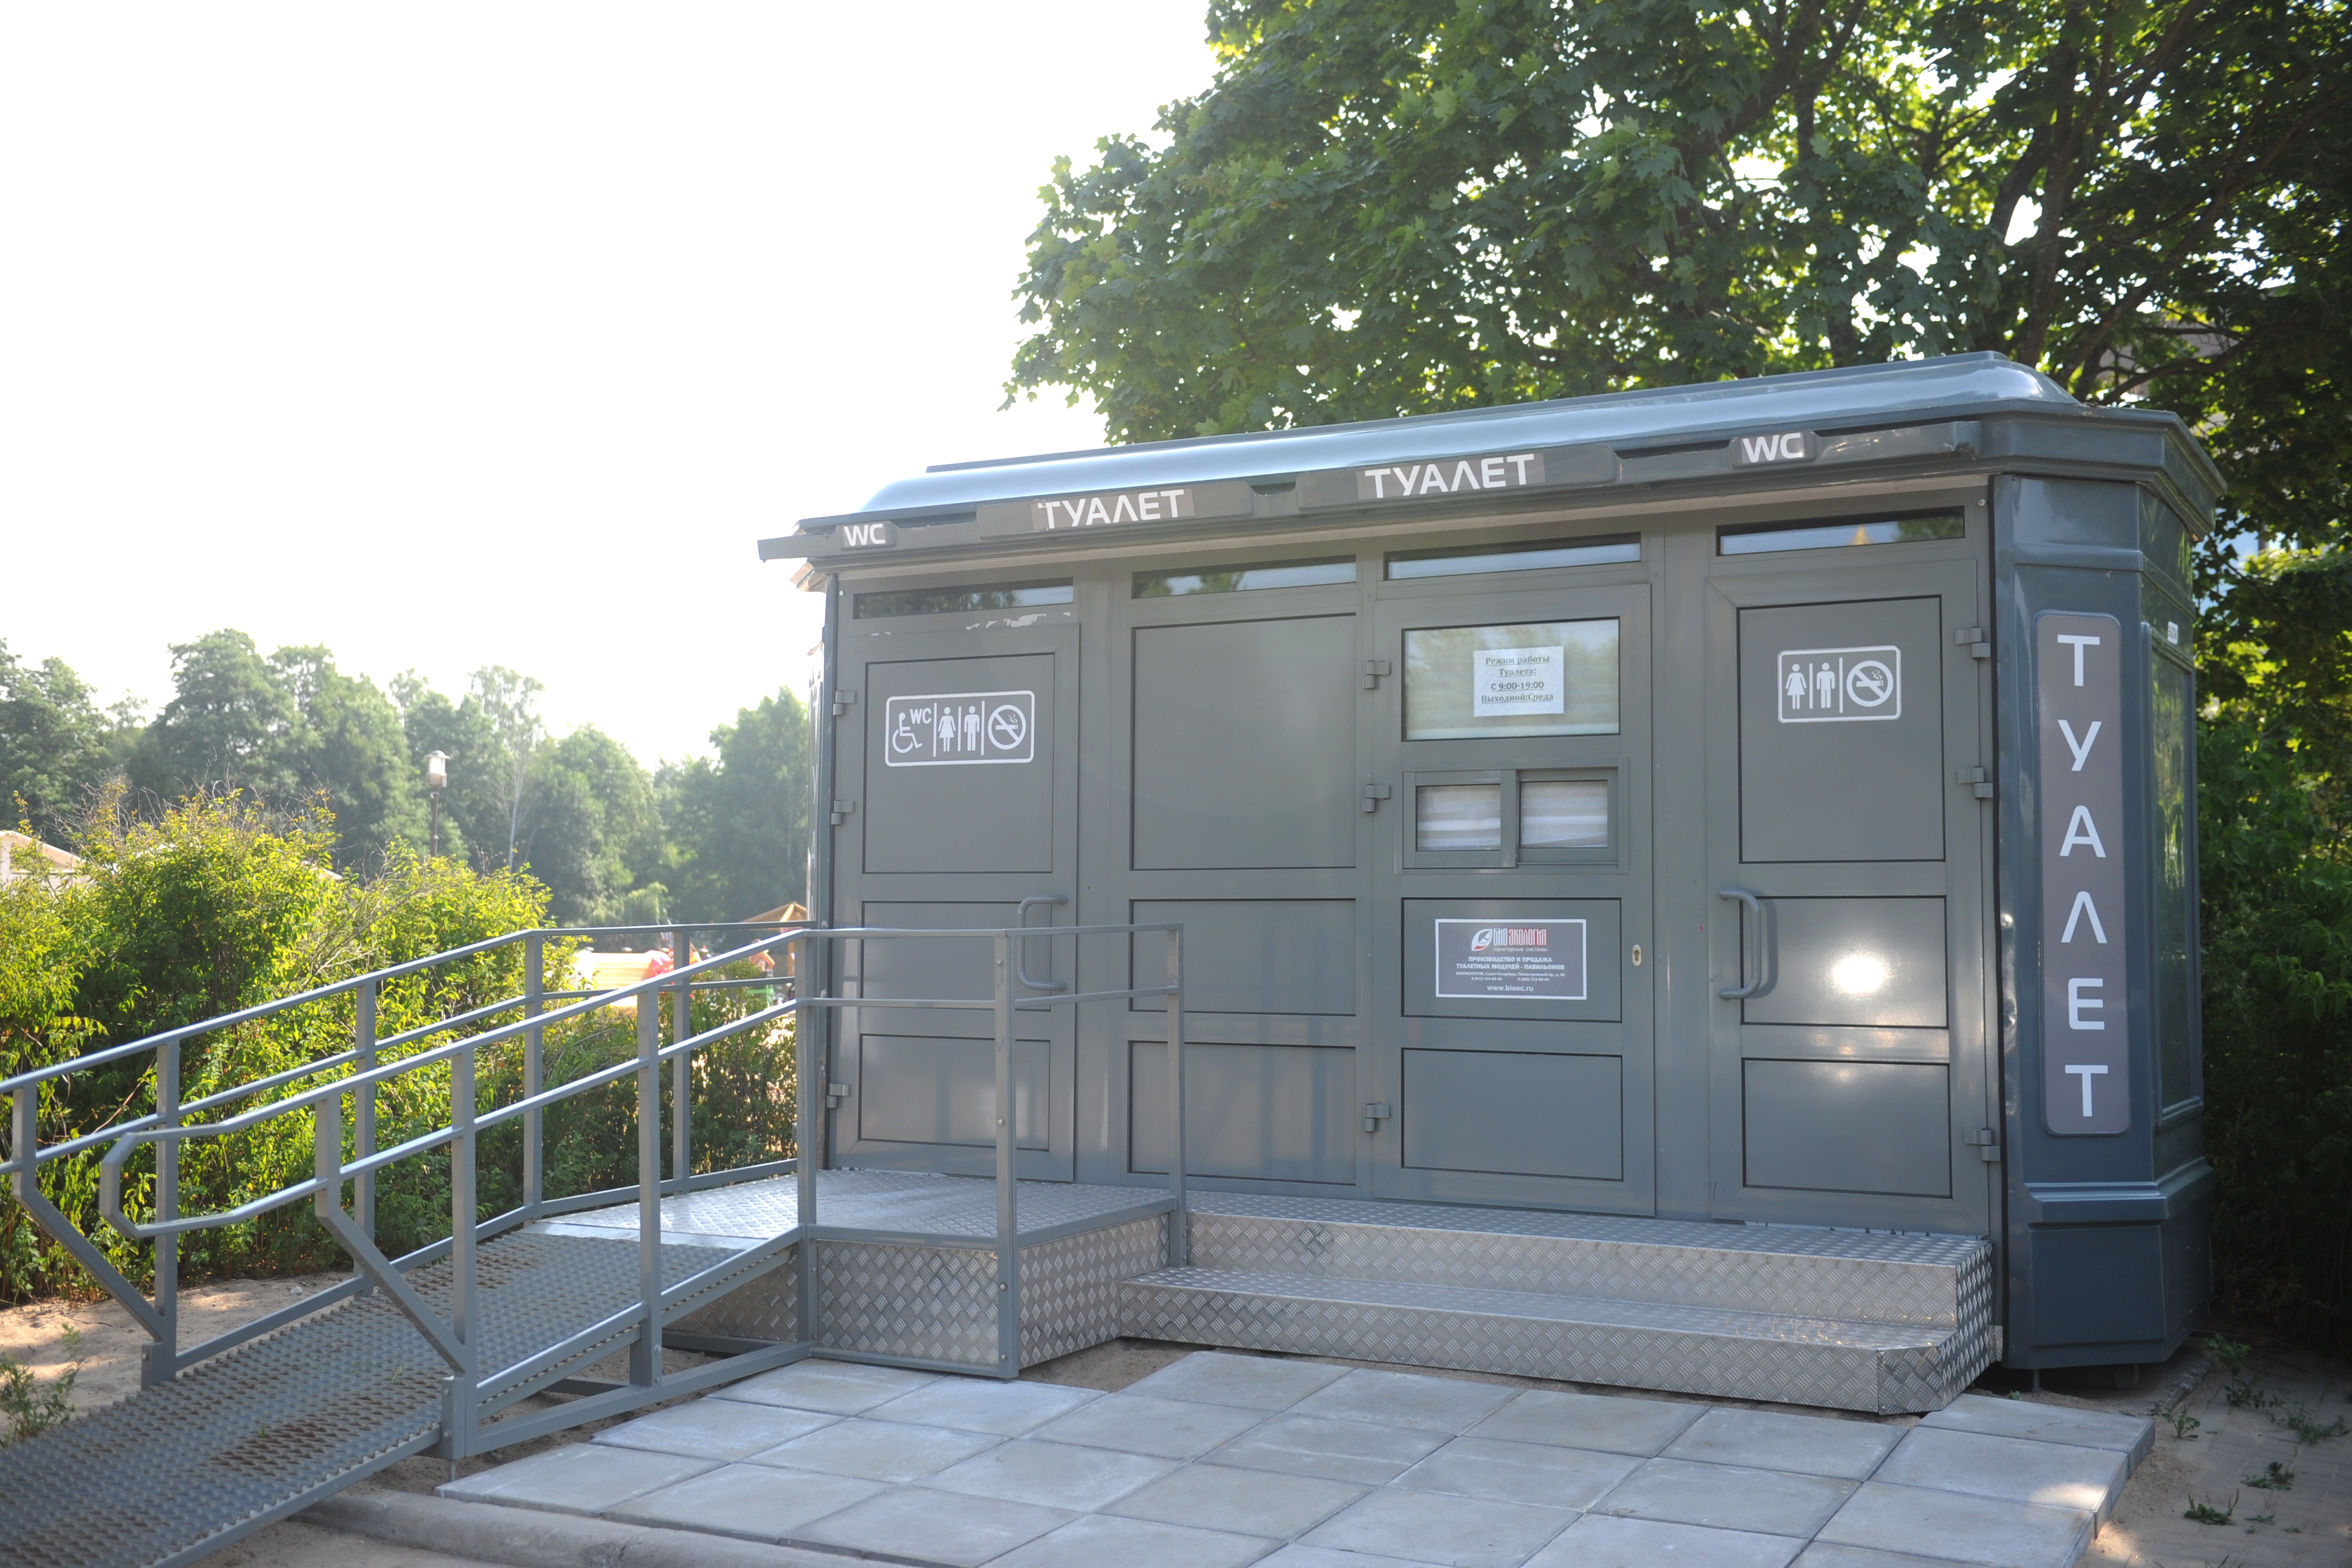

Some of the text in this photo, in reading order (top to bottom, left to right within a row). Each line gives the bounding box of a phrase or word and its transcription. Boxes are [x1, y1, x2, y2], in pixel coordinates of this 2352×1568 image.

[1742, 432, 1803, 463] WC
[1365, 454, 1535, 498] ТУАЛЕТ
[1038, 489, 1184, 529] ТУАЛЕТ
[843, 523, 886, 547] WC
[1498, 668, 1536, 677] Туалета:
[1517, 656, 1550, 665] работы
[1498, 681, 1544, 691] 9:00-19:00
[910, 707, 932, 725] WC
[2057, 634, 2109, 1117] ТУАЛЕТ
